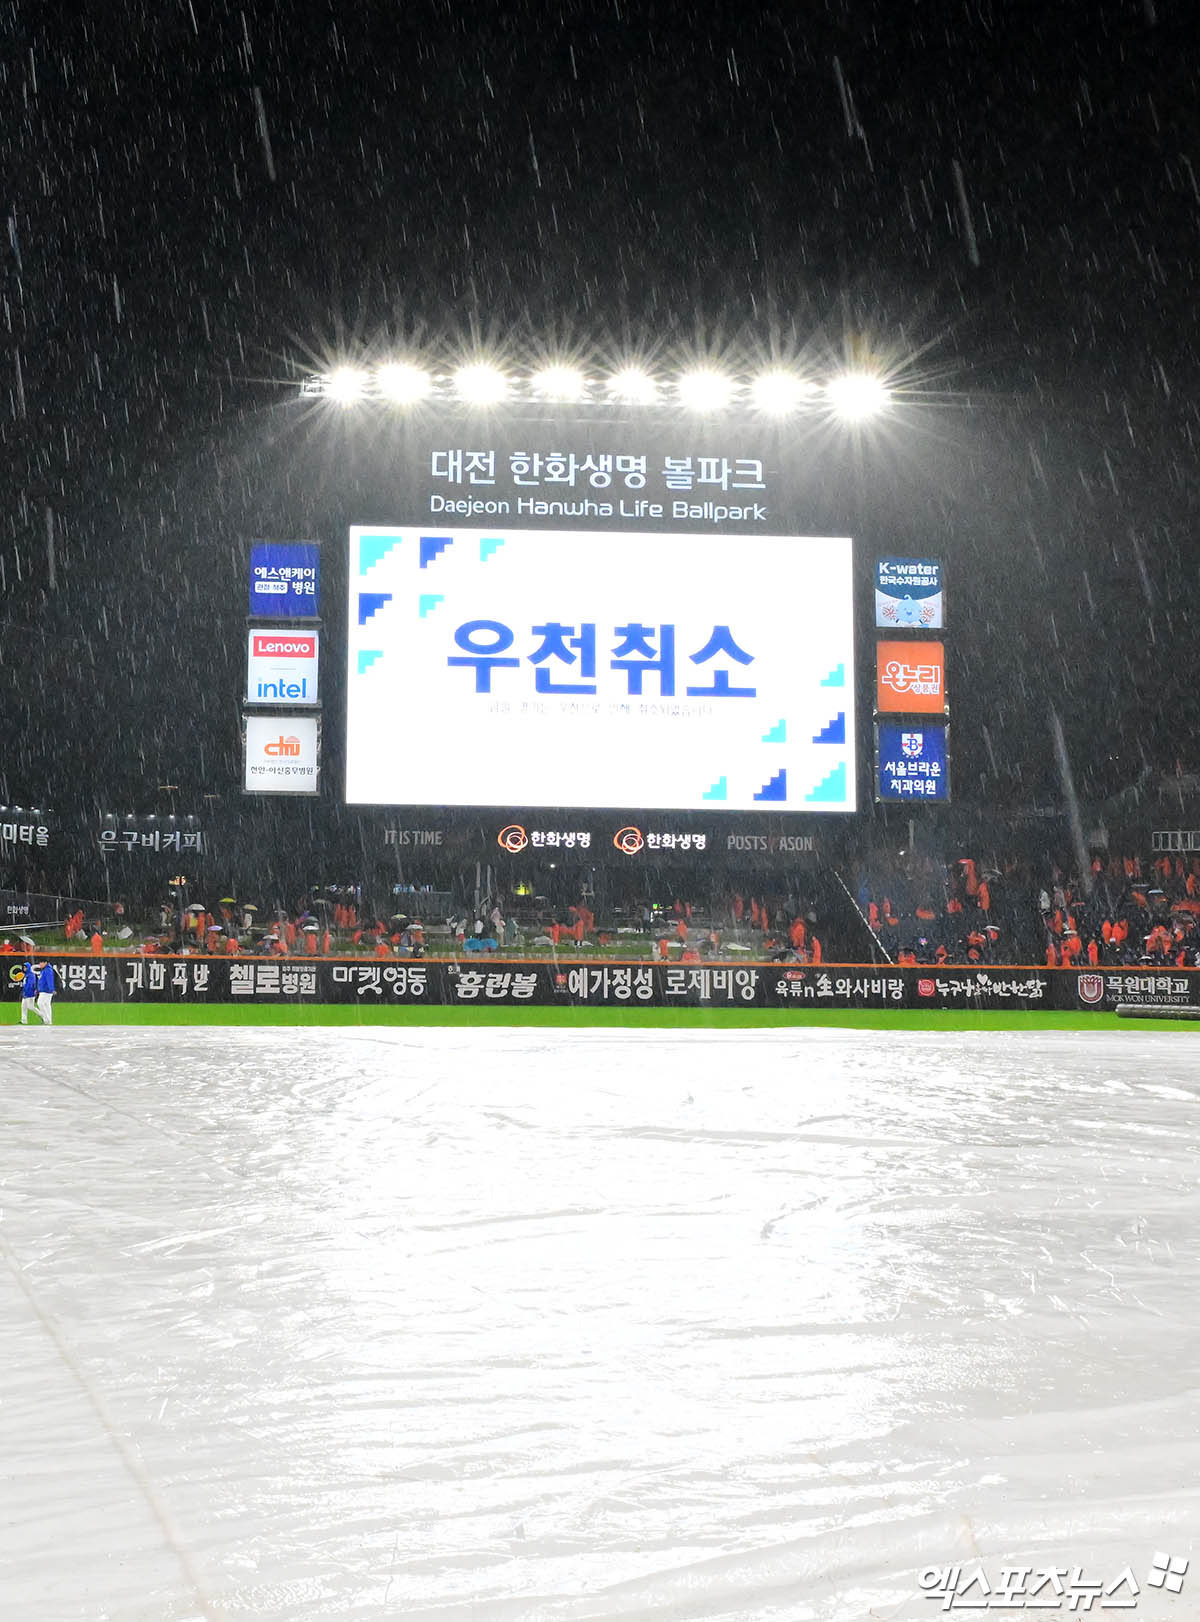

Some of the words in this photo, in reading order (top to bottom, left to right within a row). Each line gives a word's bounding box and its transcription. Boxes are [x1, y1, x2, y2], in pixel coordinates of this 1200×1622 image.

[431, 450, 495, 486] 대전
[509, 452, 647, 489] 한화생명
[662, 456, 766, 491] 볼파크
[430, 495, 510, 517] Daejeon
[517, 497, 613, 516] Hanwha
[620, 499, 663, 517] Life
[673, 501, 767, 523] Ballpark
[254, 567, 315, 581] 에스앤케이
[879, 562, 939, 575] K-water
[292, 582, 315, 595] 병원
[258, 640, 310, 653] Lenovo
[447, 619, 757, 698] 우천취소
[258, 676, 307, 698] intel
[884, 761, 942, 777] 서울브라운
[891, 779, 937, 795] 치과의원
[0, 823, 49, 847] 미타올
[98, 830, 202, 853] 은구비커피
[384, 830, 397, 845] IT
[399, 830, 410, 845] IS
[413, 830, 443, 845] TIME
[531, 831, 591, 848] 한화생명
[646, 833, 706, 850] 한화생명
[455, 971, 537, 998] 홈런볼
[568, 968, 654, 999] 예가정성
[666, 970, 759, 1000] 로제비앙
[1106, 976, 1190, 995] 목원대학교
[1145, 995, 1190, 1003] UNIVERSITY
